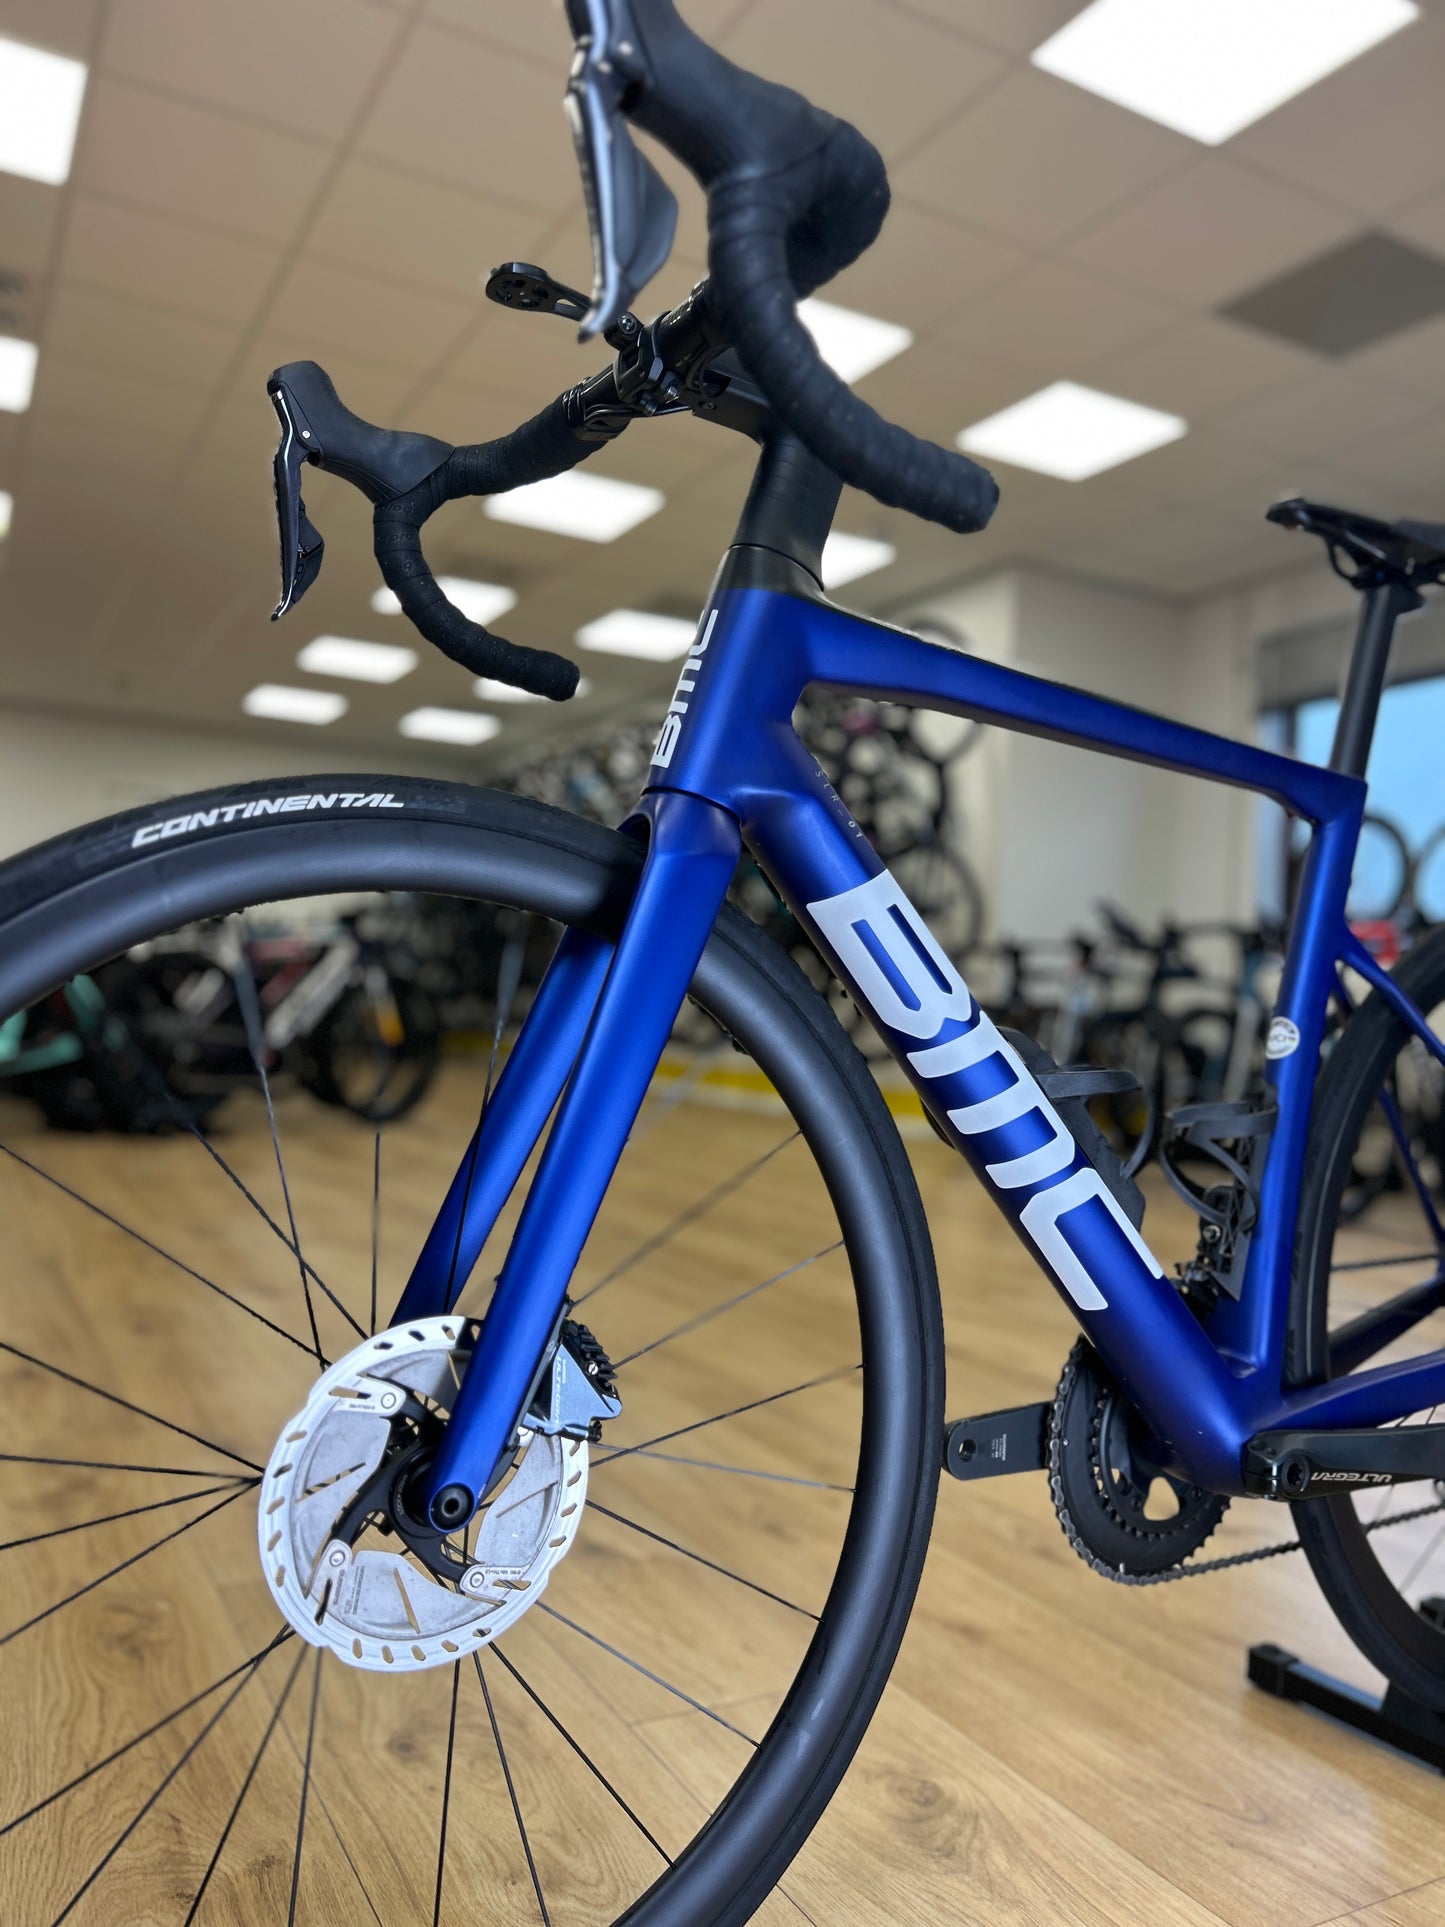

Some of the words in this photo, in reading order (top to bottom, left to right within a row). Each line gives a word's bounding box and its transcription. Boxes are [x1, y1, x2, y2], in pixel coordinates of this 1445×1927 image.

[650, 609, 719, 768] BMC
[131, 793, 404, 848] CONTINENTAL
[806, 869, 1164, 1311] BMC
[1310, 1471, 1392, 1483] ULTEGRA
